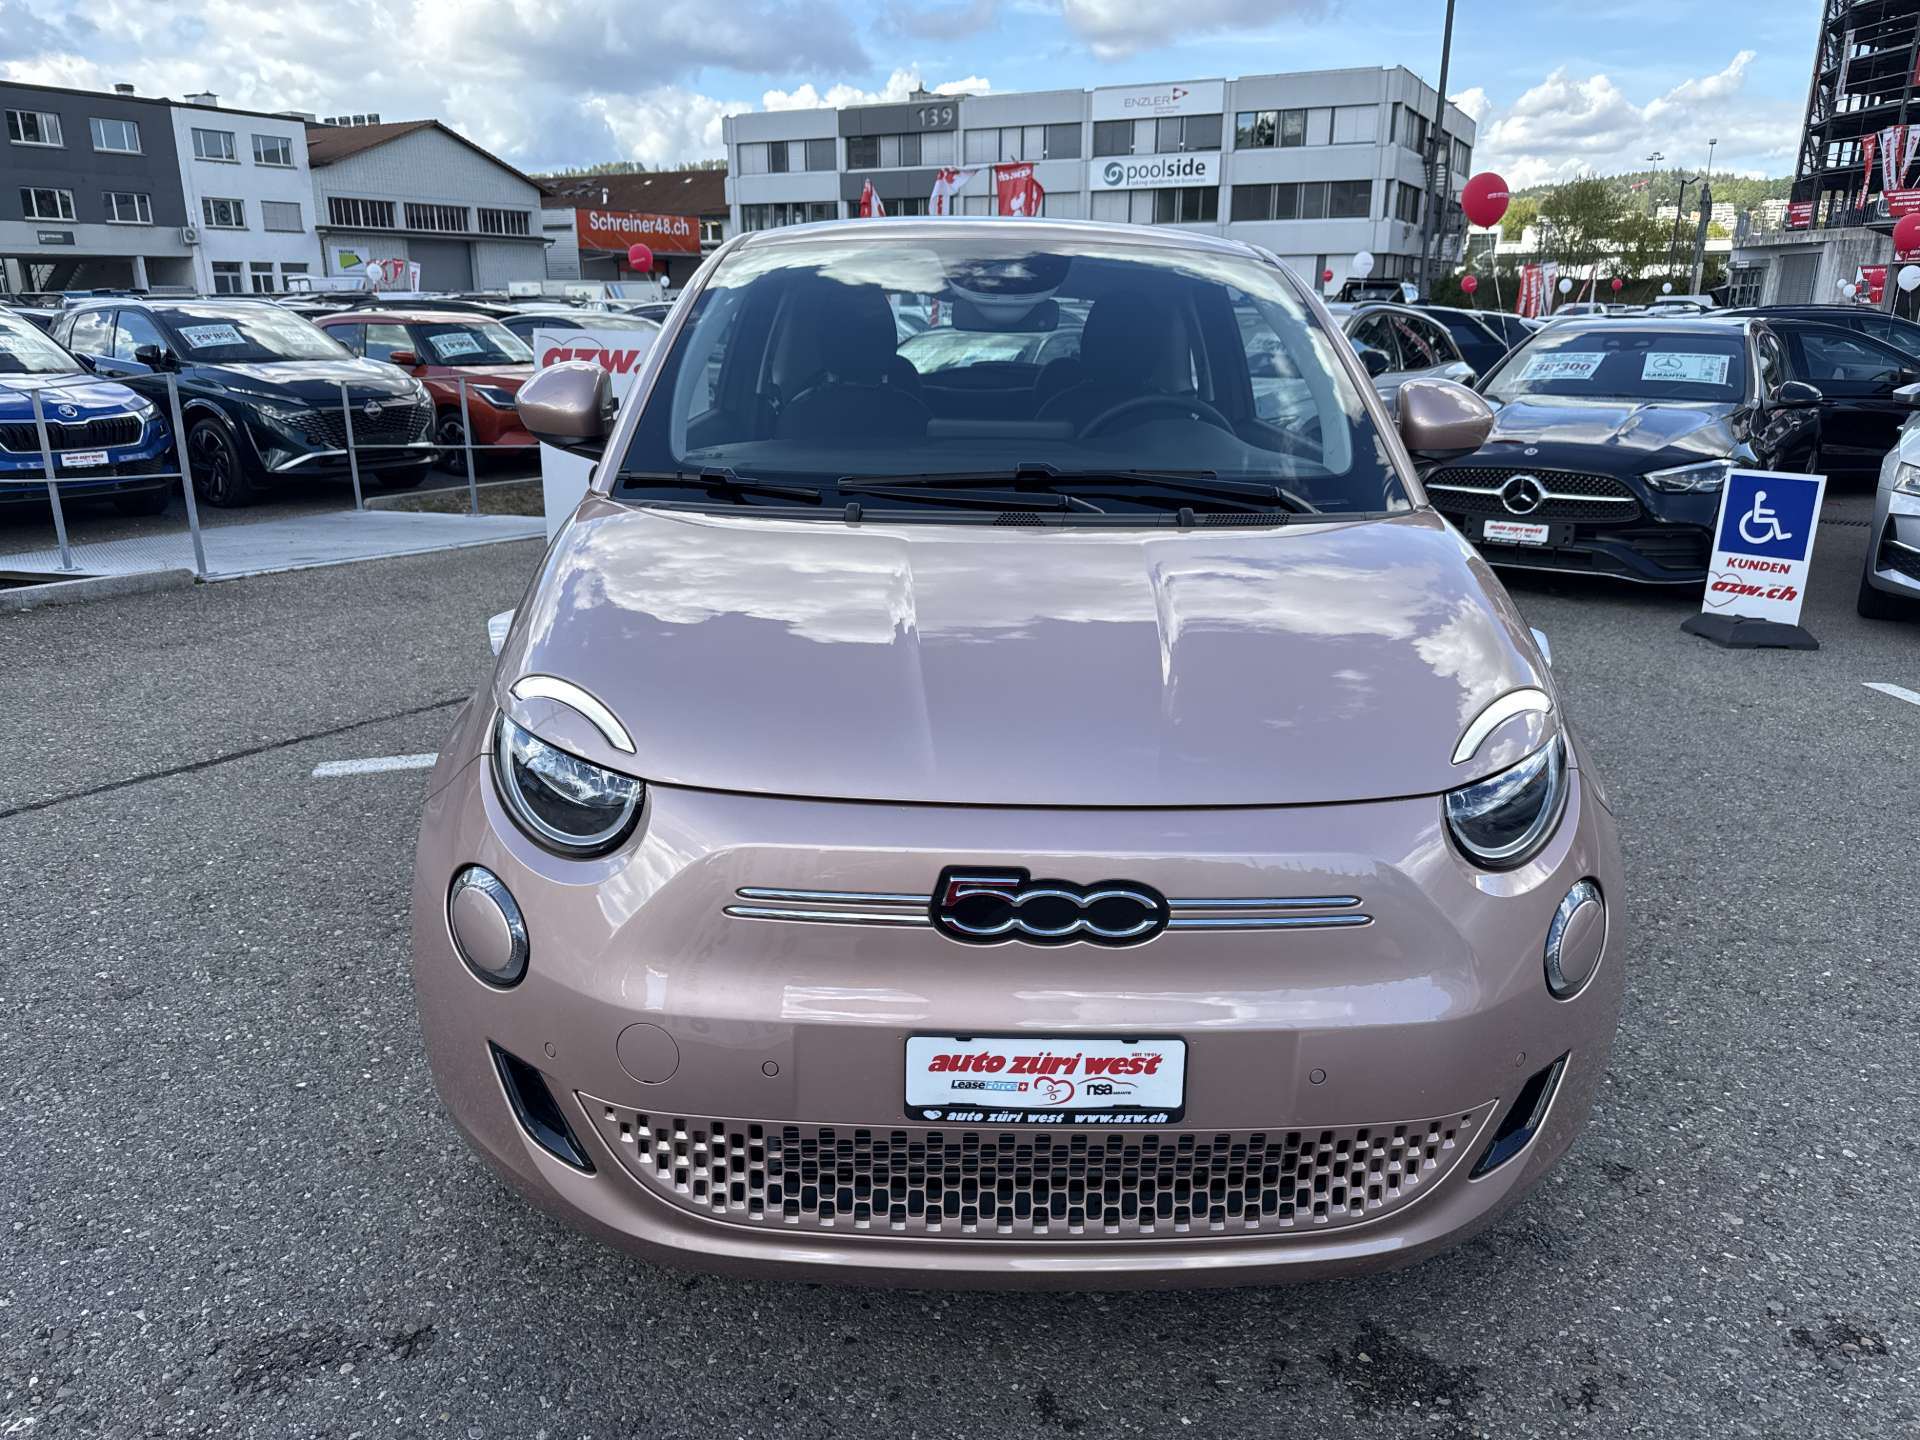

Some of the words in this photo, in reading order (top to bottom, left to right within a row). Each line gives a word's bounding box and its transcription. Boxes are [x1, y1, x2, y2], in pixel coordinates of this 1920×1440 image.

[1123, 94, 1171, 108] ENZLER
[917, 107, 953, 127] 139
[1126, 157, 1206, 186] poolside
[589, 210, 690, 236] Schreiner48.ch
[1726, 557, 1791, 574] KUNDEN
[1711, 581, 1798, 601] azw.ch
[941, 876, 1158, 936] 500
[928, 1051, 1006, 1073] auto
[1006, 1052, 1082, 1075] züri
[1084, 1053, 1163, 1075] west
[951, 1080, 1018, 1091] LeaseForce
[1086, 1084, 1112, 1095] nsa
[947, 1111, 983, 1122] auto
[987, 1112, 1022, 1123] züri
[1027, 1113, 1064, 1123] west
[1074, 1114, 1168, 1124] www.azw.ch
